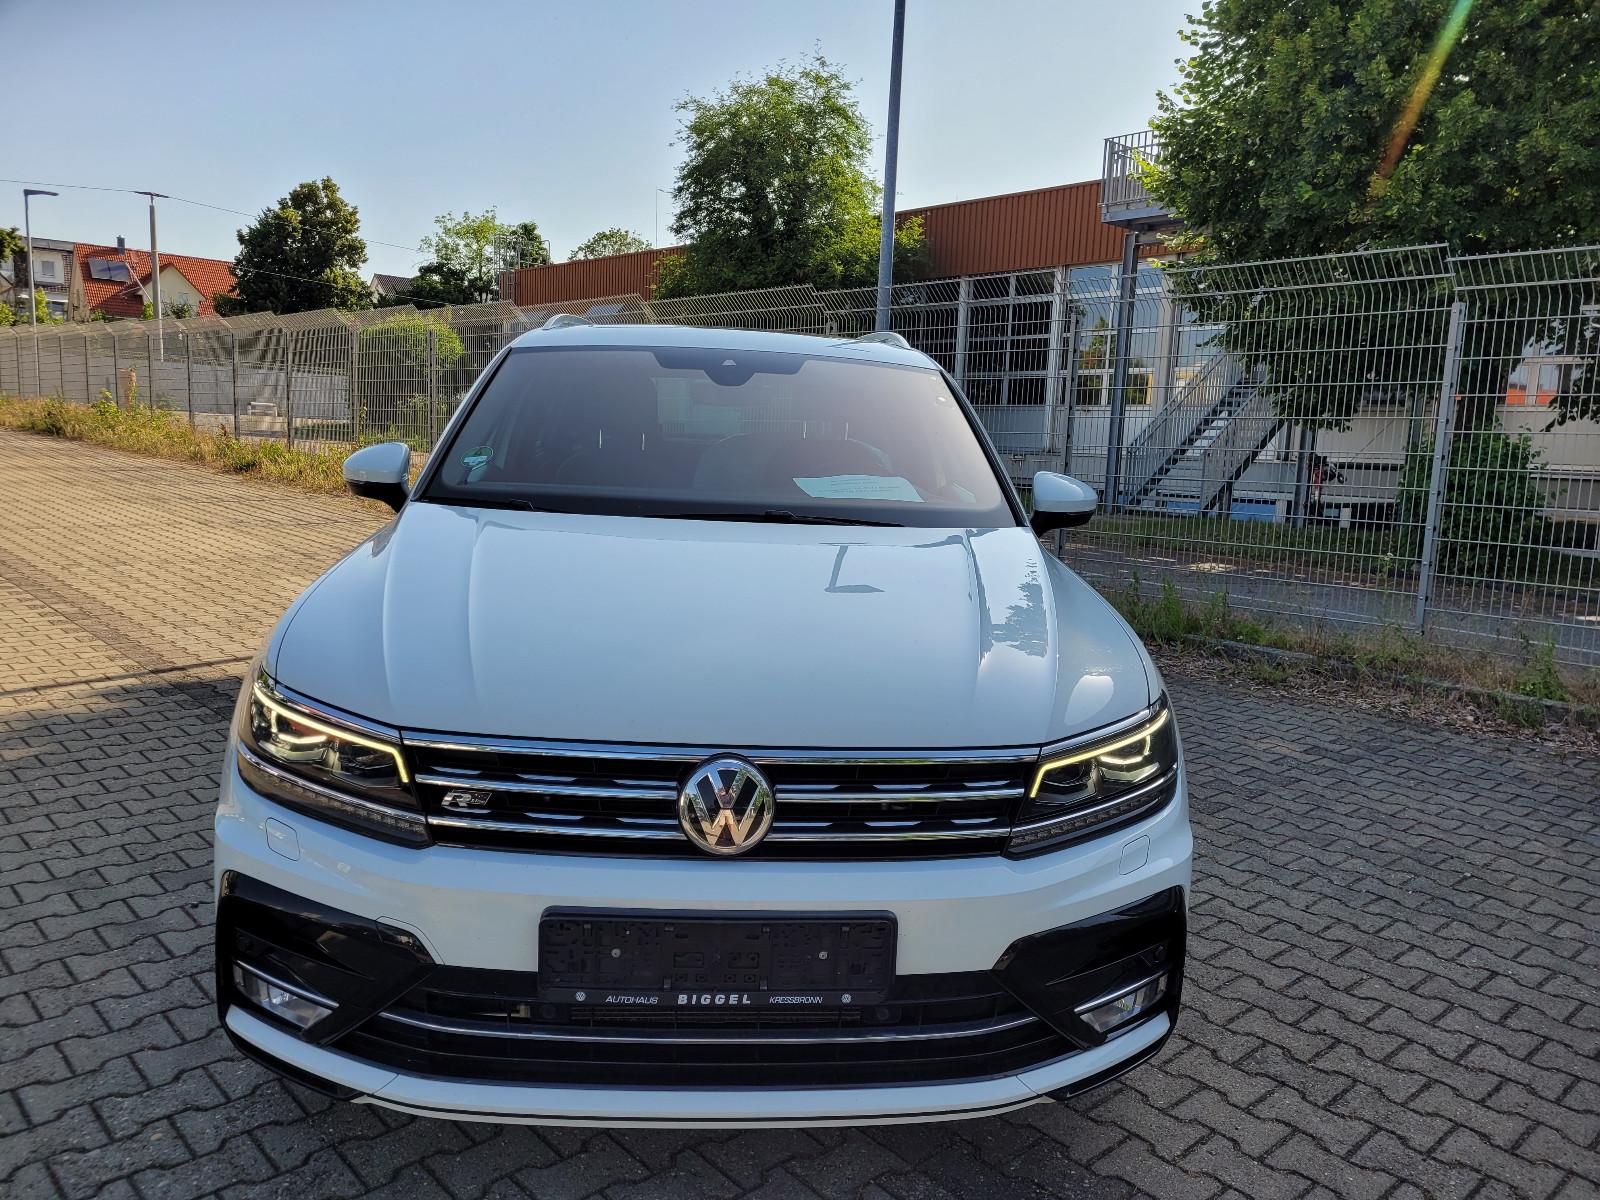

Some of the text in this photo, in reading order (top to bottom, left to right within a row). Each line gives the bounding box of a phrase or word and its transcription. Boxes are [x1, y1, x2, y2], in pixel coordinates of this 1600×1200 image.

[604, 994, 823, 1005] AUTOHAUS BIGGEL KRESSBRONN
